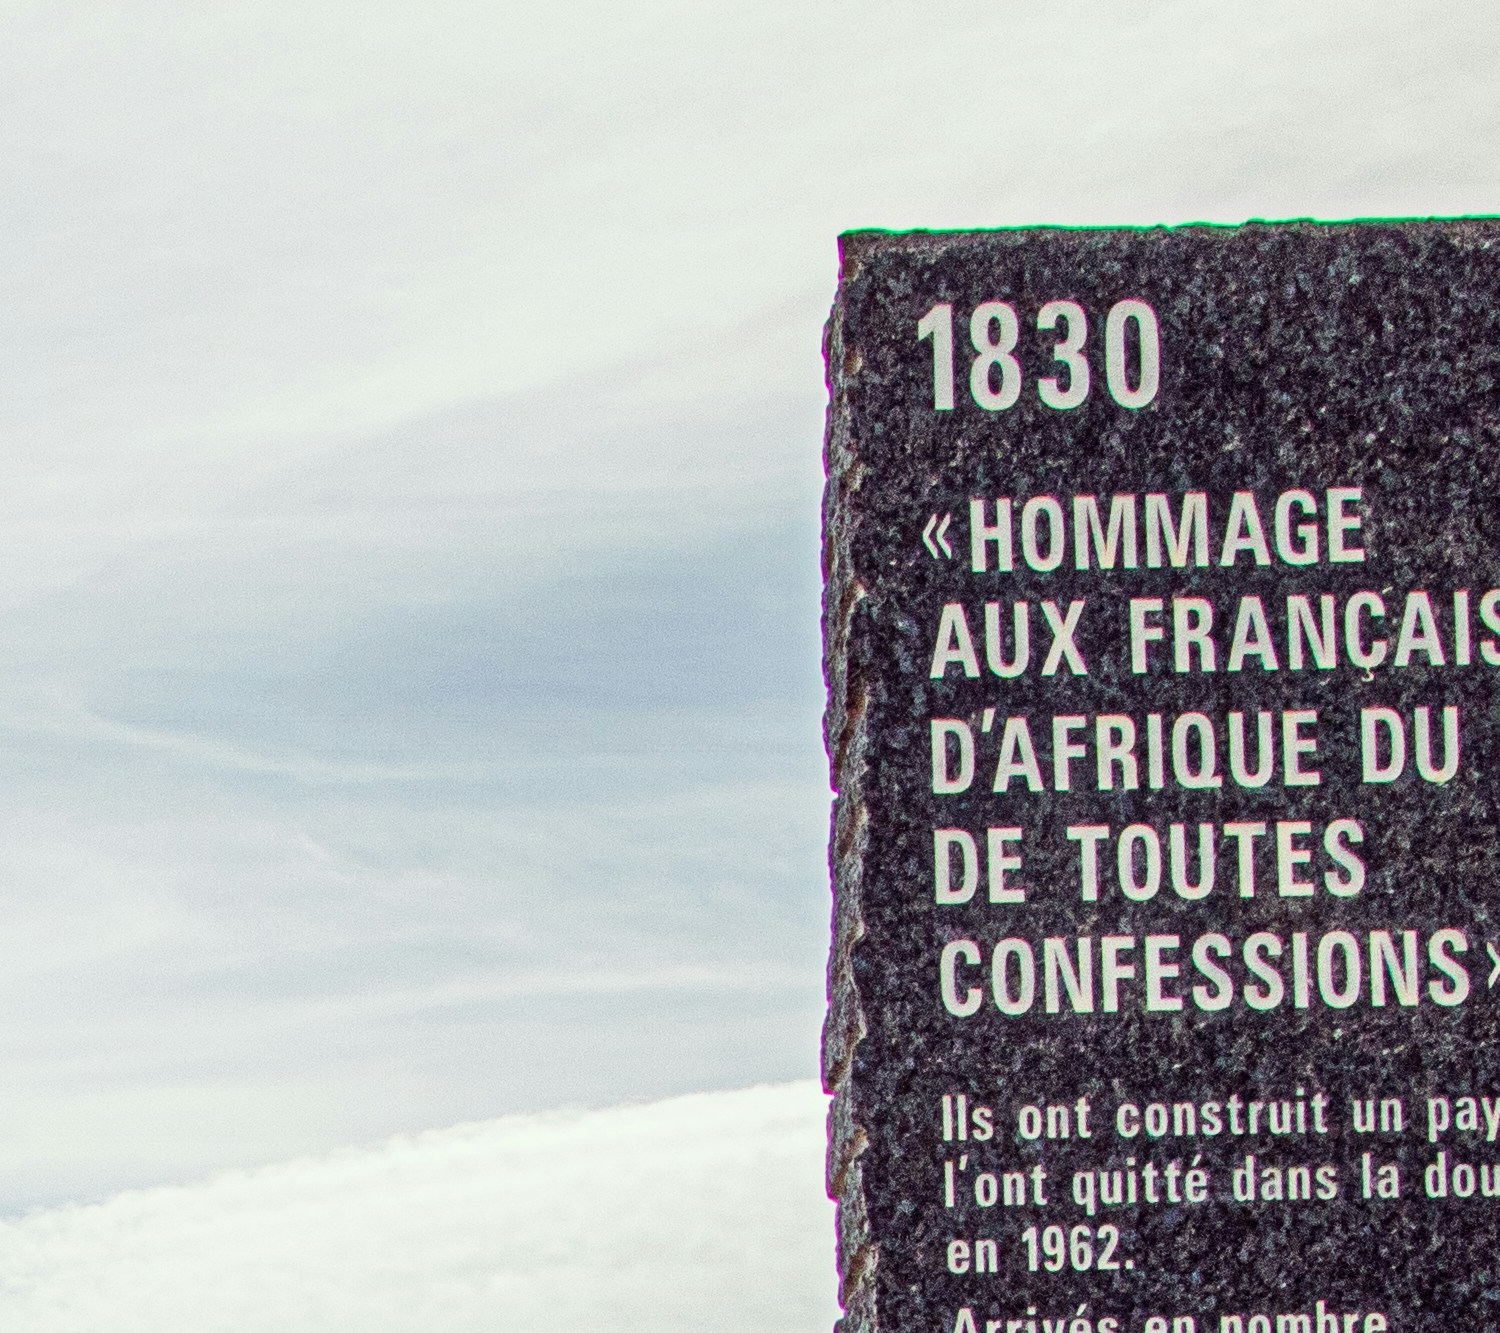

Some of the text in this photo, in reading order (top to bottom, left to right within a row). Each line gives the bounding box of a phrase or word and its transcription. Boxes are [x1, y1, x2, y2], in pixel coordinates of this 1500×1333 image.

[917, 300, 1160, 411] 1830
[930, 600, 1088, 678] AUX
[931, 707, 1321, 794] D'AFRIQUE
[1361, 706, 1459, 786] DU
[934, 819, 1366, 904] DE TOUTES
[941, 1094, 994, 1142] Ils
[1018, 1097, 1092, 1140] ont
[1116, 1087, 1328, 1138] construit
[1353, 1098, 1404, 1133] un
[944, 1154, 1048, 1208] l'ont
[1072, 1154, 1208, 1216] quitté
[1233, 1155, 1338, 1202] dans
[1362, 1152, 1400, 1199] la
[947, 1224, 1136, 1274] en 1962.
